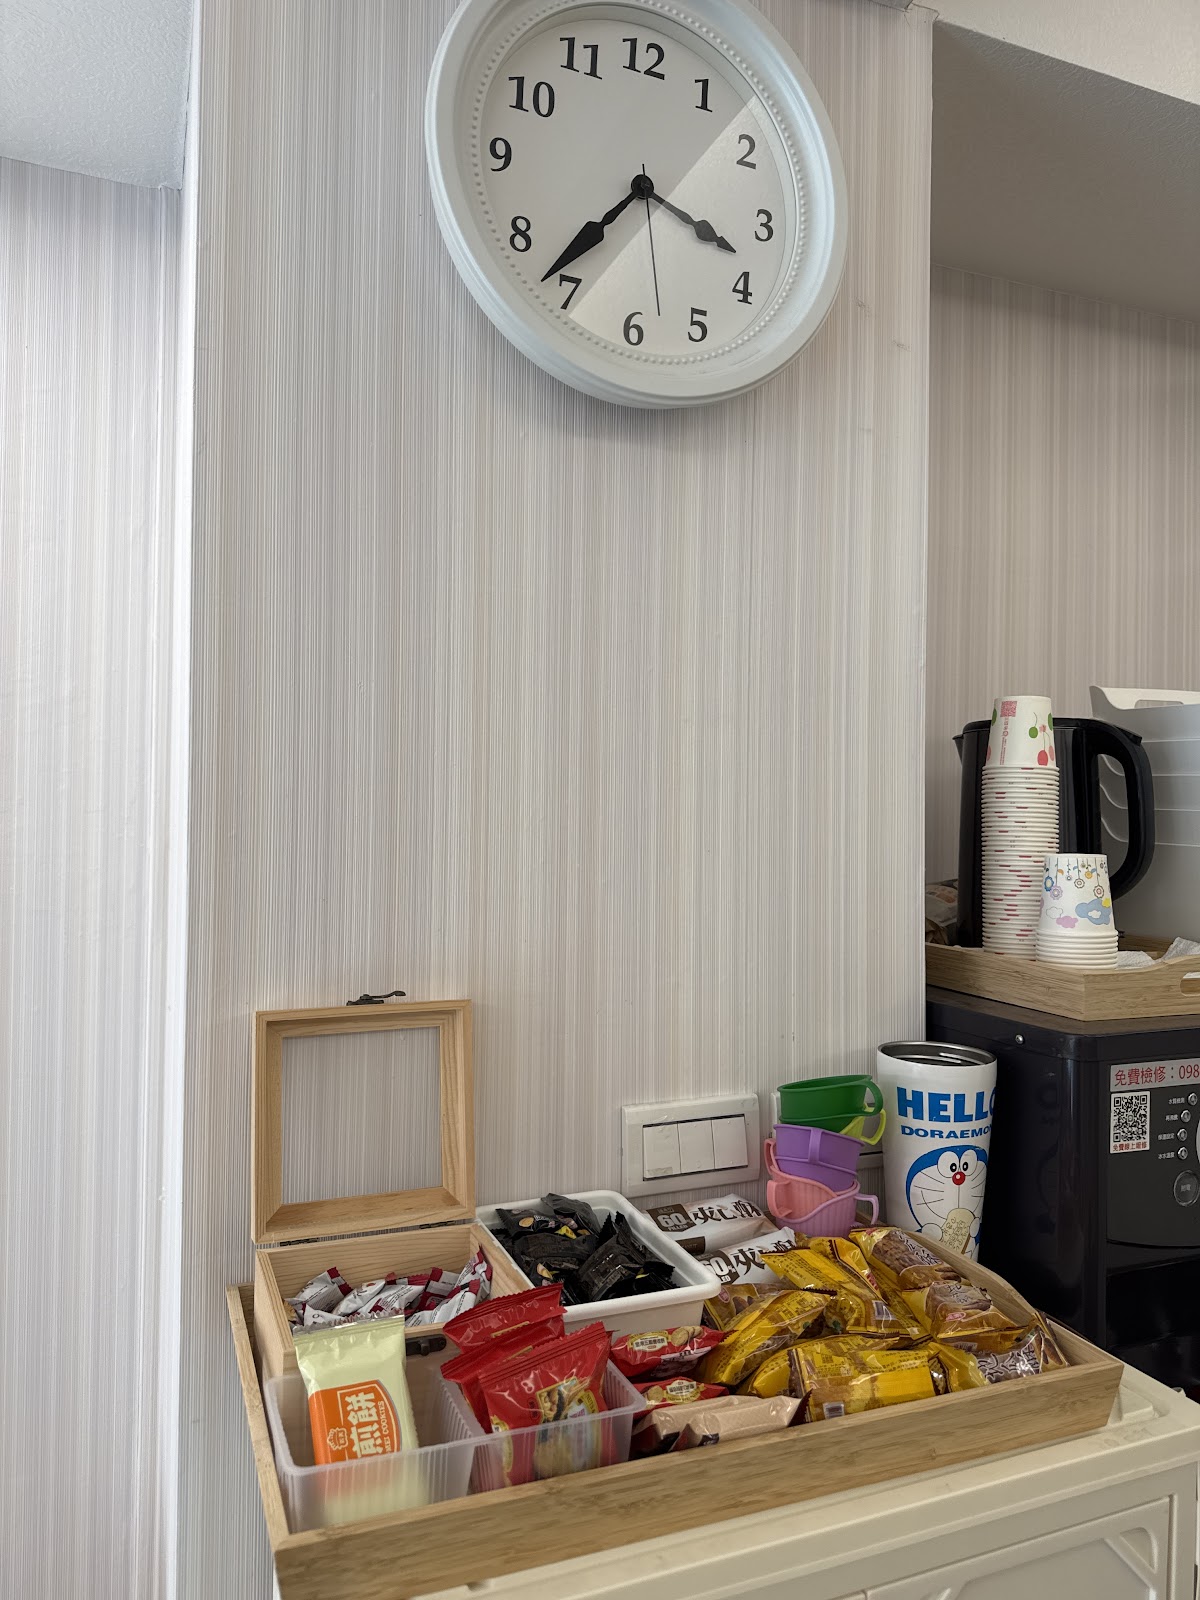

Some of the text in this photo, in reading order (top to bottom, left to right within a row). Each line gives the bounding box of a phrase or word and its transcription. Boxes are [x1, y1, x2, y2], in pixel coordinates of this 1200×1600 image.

[559, 36, 603, 80] 11
[621, 37, 666, 81] 12
[508, 75, 556, 118] 10
[694, 78, 714, 113] 1
[488, 136, 513, 172] 9
[736, 133, 758, 170] 2
[508, 215, 533, 253] 8
[753, 208, 774, 242] 3
[558, 273, 582, 311] 7
[731, 271, 753, 306] 4
[622, 311, 645, 347] 6
[687, 306, 709, 343] 5
[901, 1124, 992, 1139] DORAEMO
[345, 1392, 384, 1458] 煎餅
[378, 1400, 390, 1435] COOKIES
